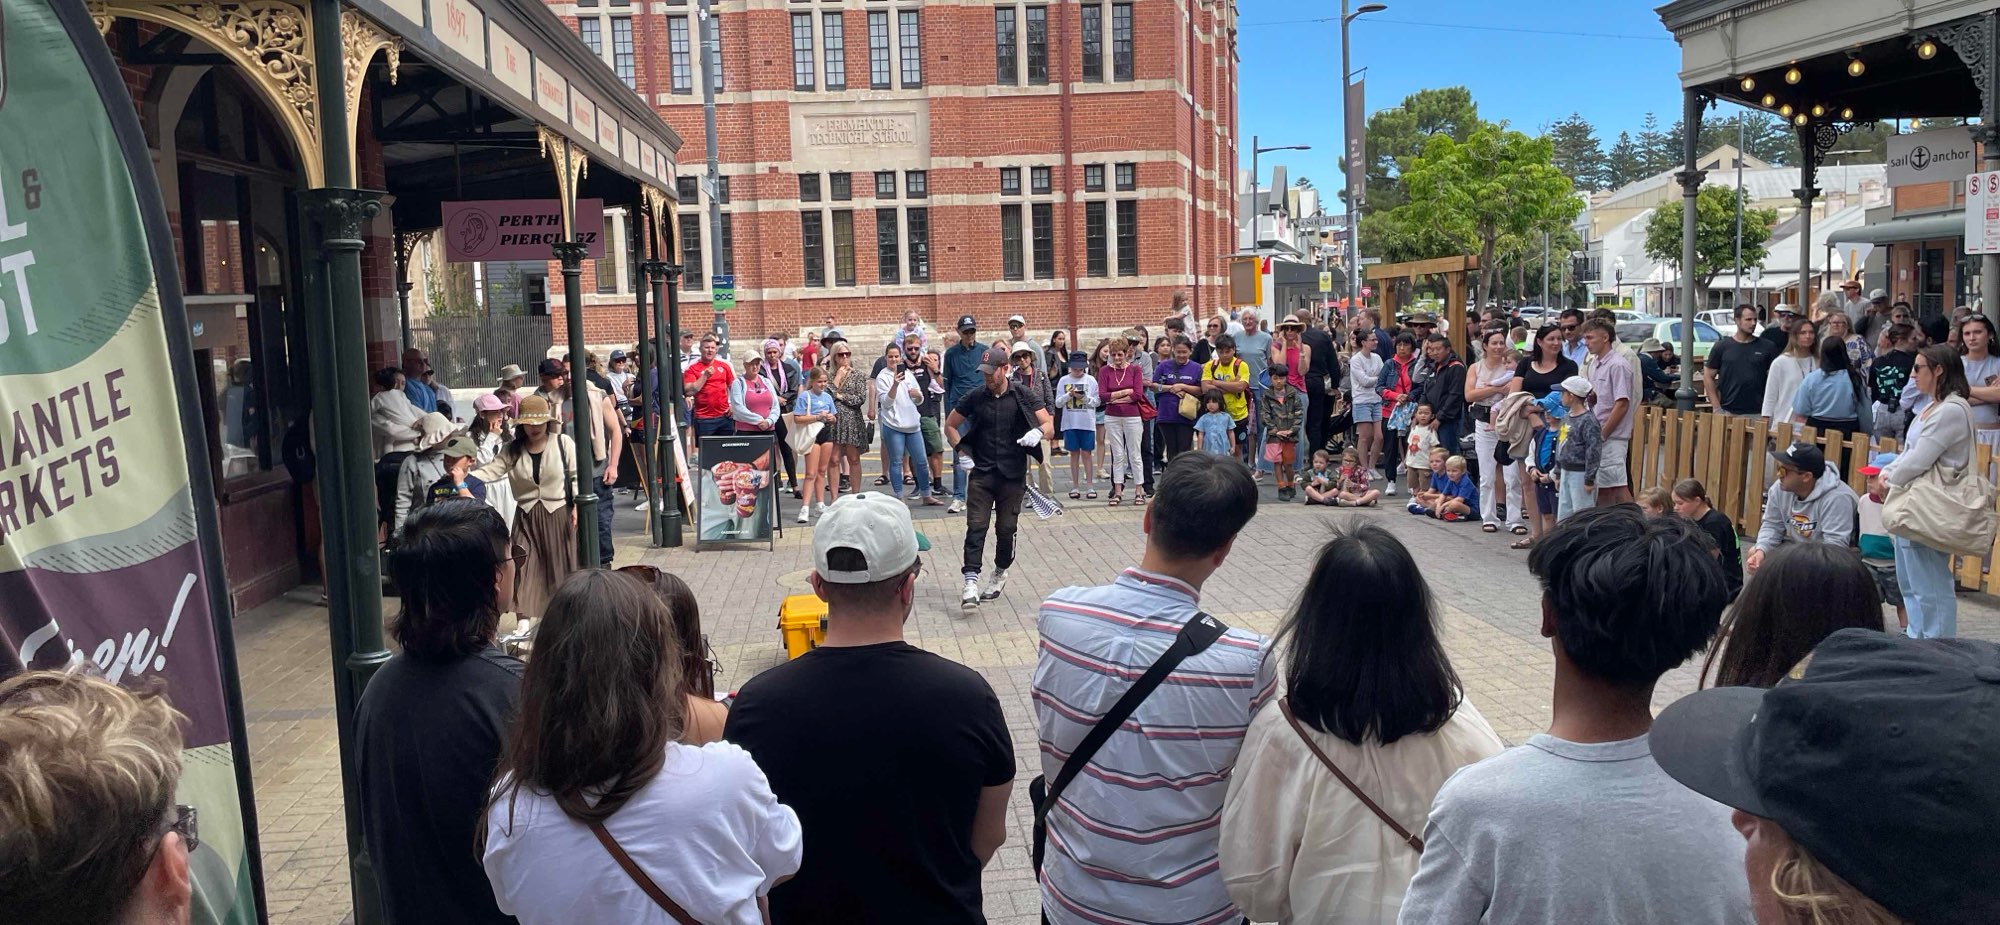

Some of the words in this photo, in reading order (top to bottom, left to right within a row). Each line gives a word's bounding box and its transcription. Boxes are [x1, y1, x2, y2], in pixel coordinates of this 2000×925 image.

[826, 118, 895, 132] FREMANTLE
[809, 131, 869, 145] TECHNICAL
[872, 130, 913, 144] SCHOOL
[1890, 154, 1908, 167] sail
[1932, 149, 1970, 162] anchor
[22, 168, 42, 210] &
[498, 214, 561, 227] PERTH
[500, 232, 597, 246] PIERCIGZ
[0, 436, 121, 545] RKETS
